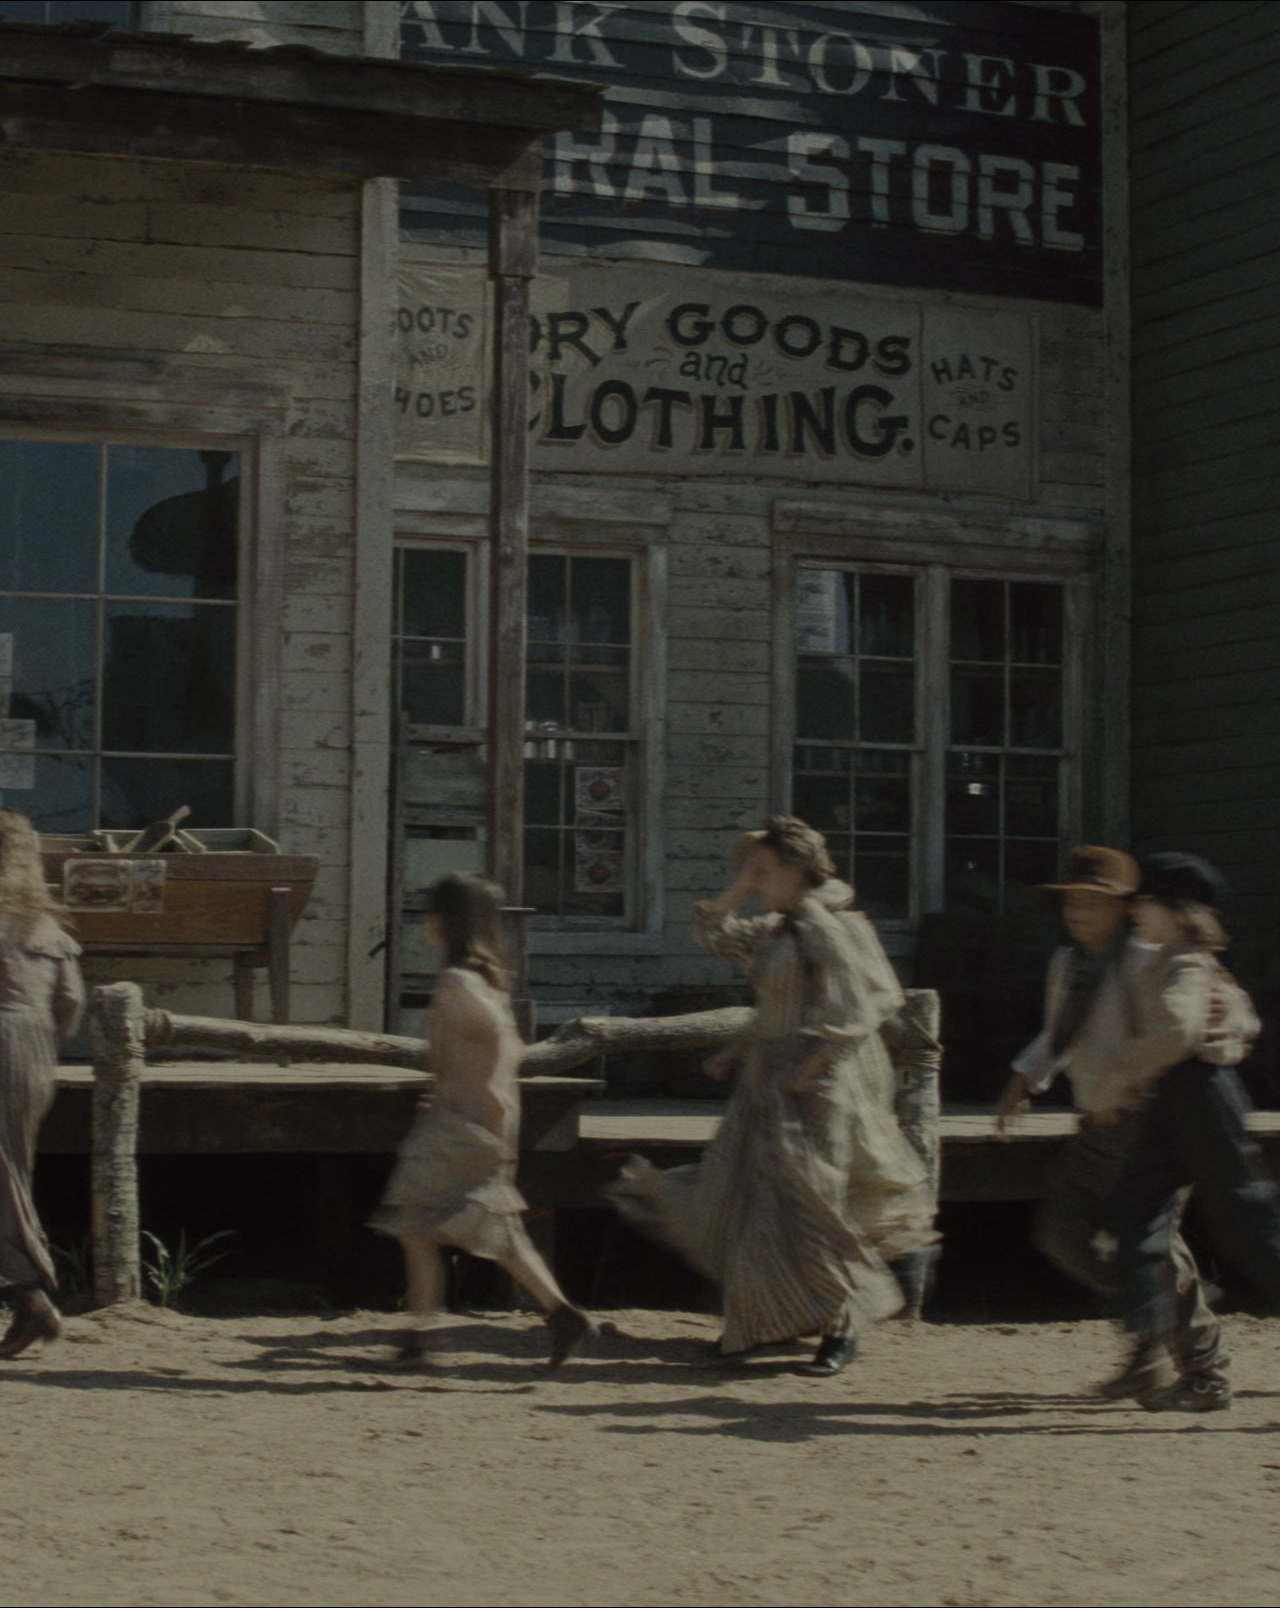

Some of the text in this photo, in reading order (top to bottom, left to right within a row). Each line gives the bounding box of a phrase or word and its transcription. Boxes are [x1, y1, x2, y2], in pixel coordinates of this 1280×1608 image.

[672, 1, 1087, 127] STONER
[787, 130, 1084, 252] STORE
[390, 306, 474, 340] OOTS
[529, 302, 912, 376] RY GOODS
[679, 345, 749, 390] and
[928, 352, 1019, 393] HATS
[529, 370, 915, 458] LOTHING.
[926, 413, 1022, 453] CAPS
